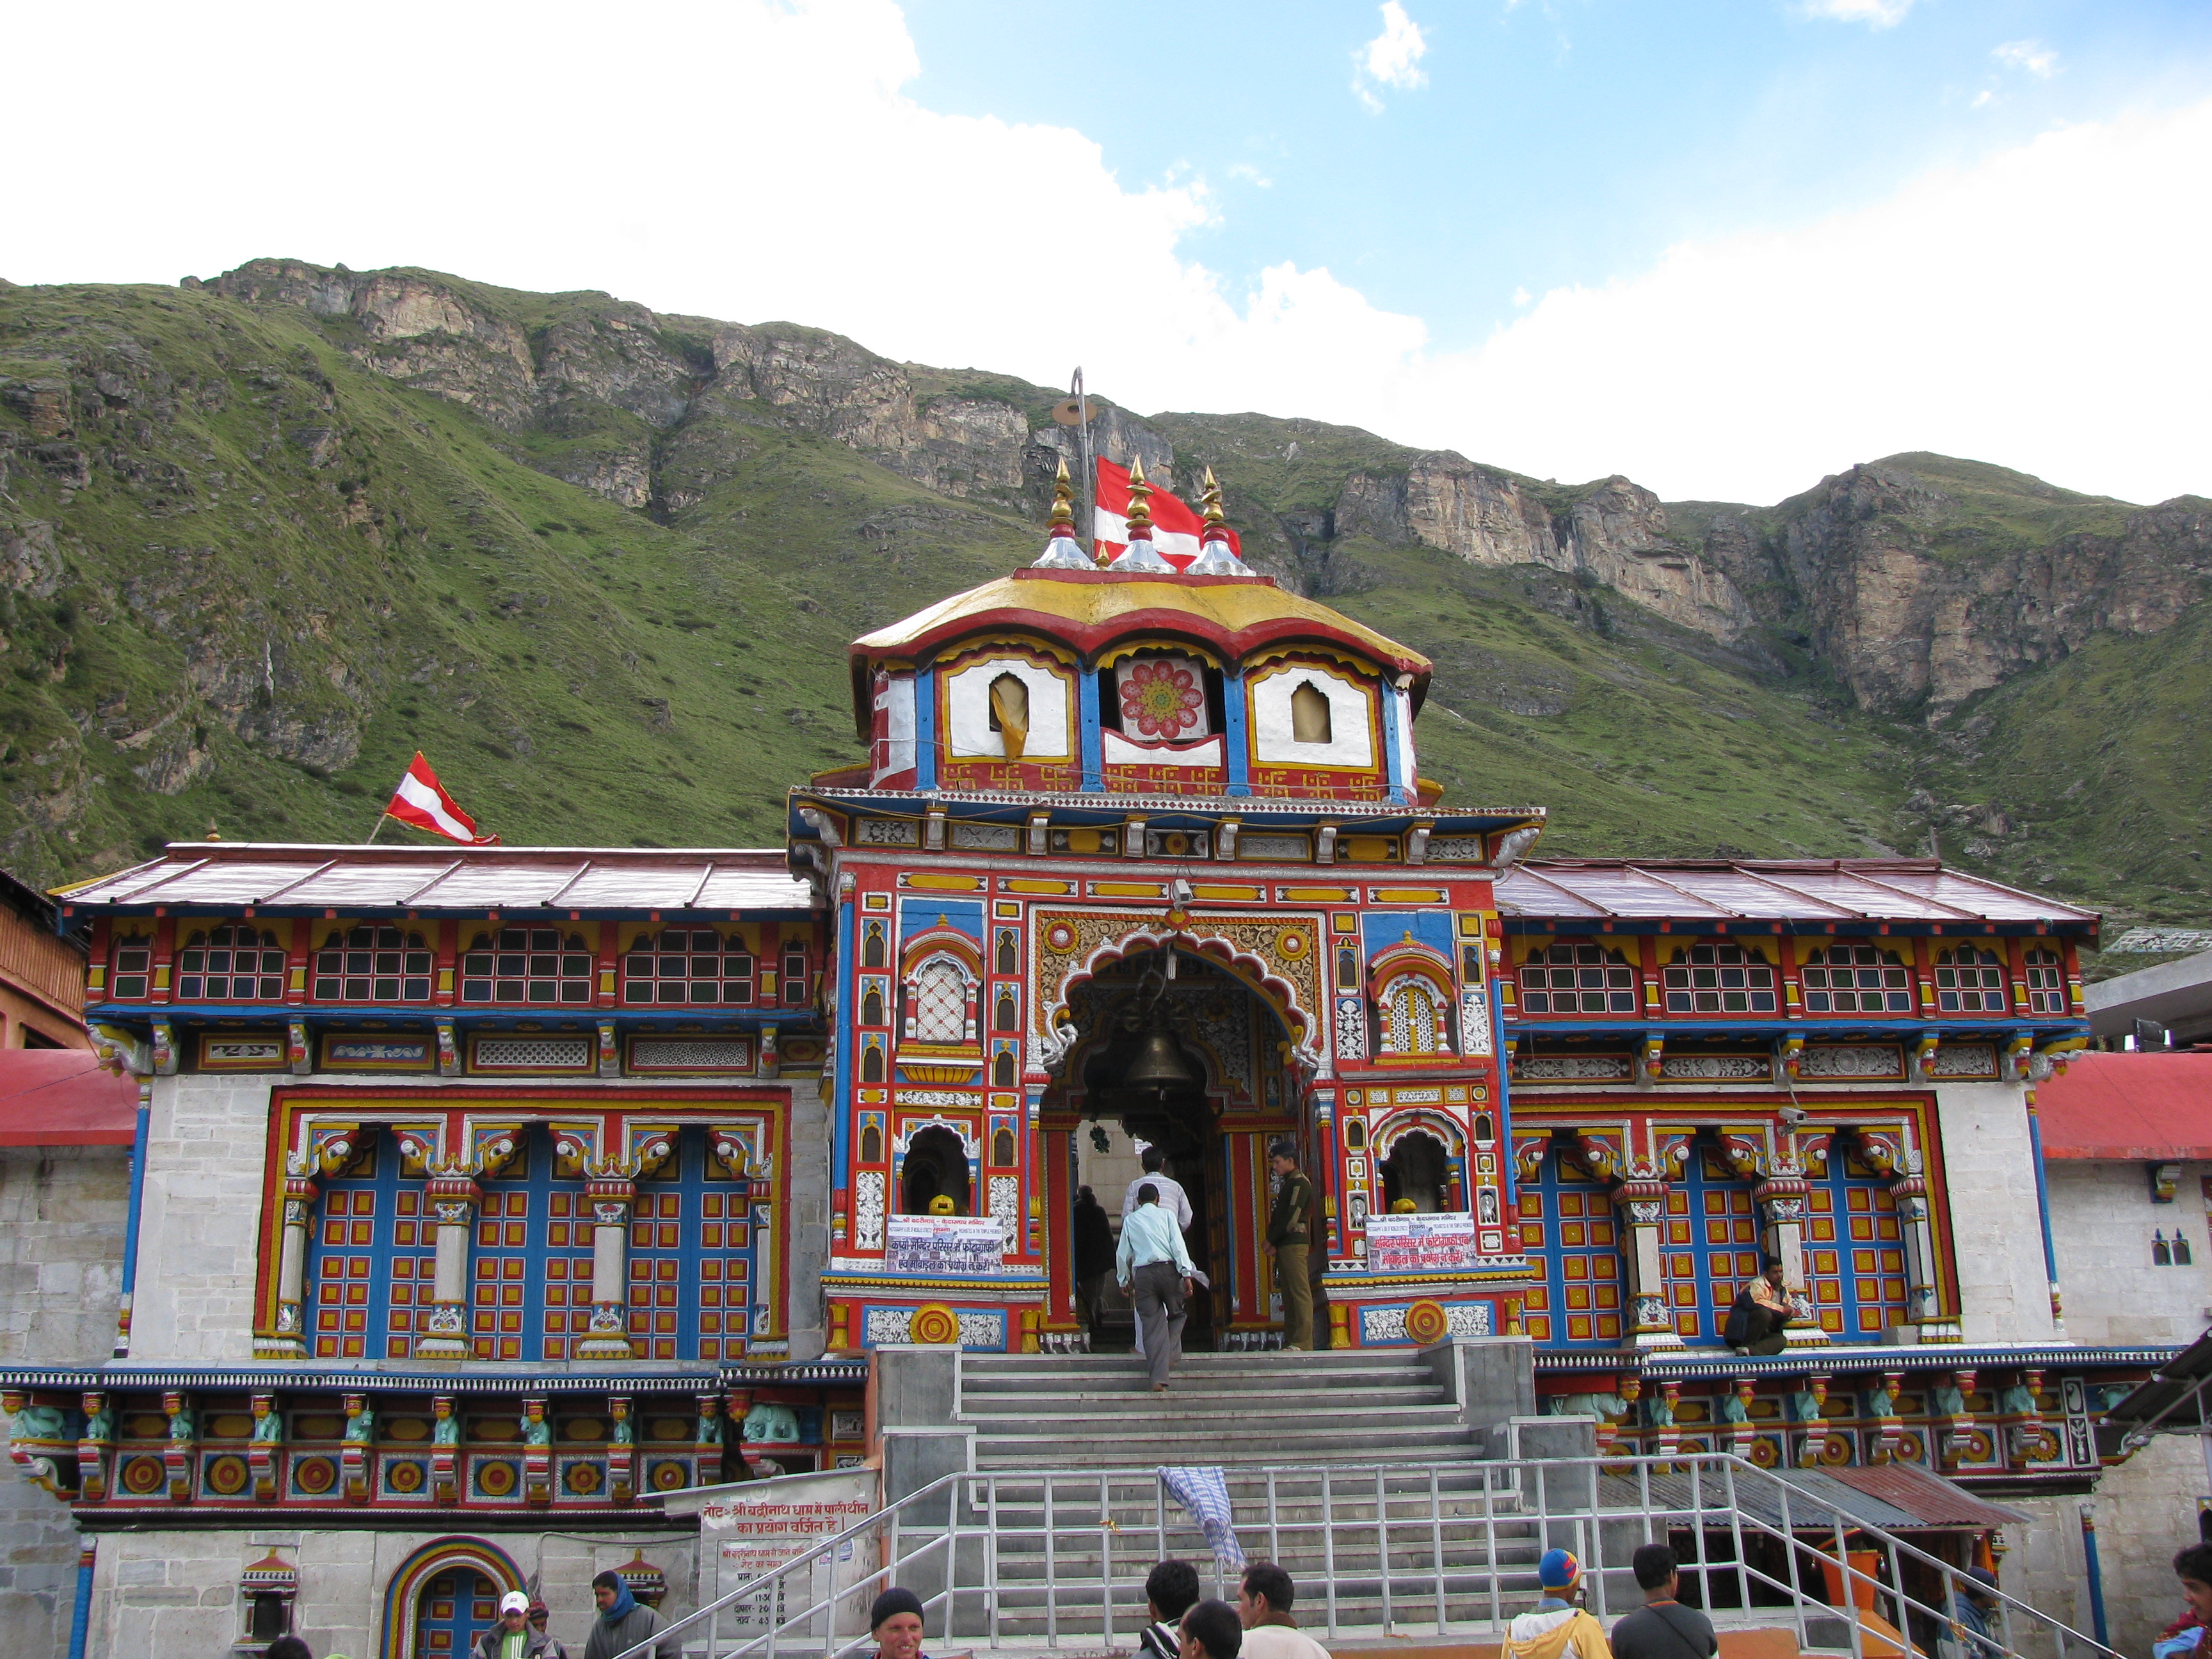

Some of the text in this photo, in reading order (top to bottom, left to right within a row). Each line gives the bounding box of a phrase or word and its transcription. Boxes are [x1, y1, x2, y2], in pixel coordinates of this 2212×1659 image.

[933, 1238, 953, 1251] परिसर
[1409, 1254, 1419, 1264] का
[1441, 1253, 1447, 1262] न
[936, 1260, 947, 1269] का
[968, 1262, 975, 1270] न
[732, 1502, 747, 1516] श्री
[792, 1504, 813, 1516] धाम
[814, 1502, 824, 1515] में
[737, 1522, 753, 1534] का
[755, 1519, 788, 1534] प्रयोग
[790, 1516, 824, 1533] वर्जित
[722, 1548, 731, 1557] श्री
